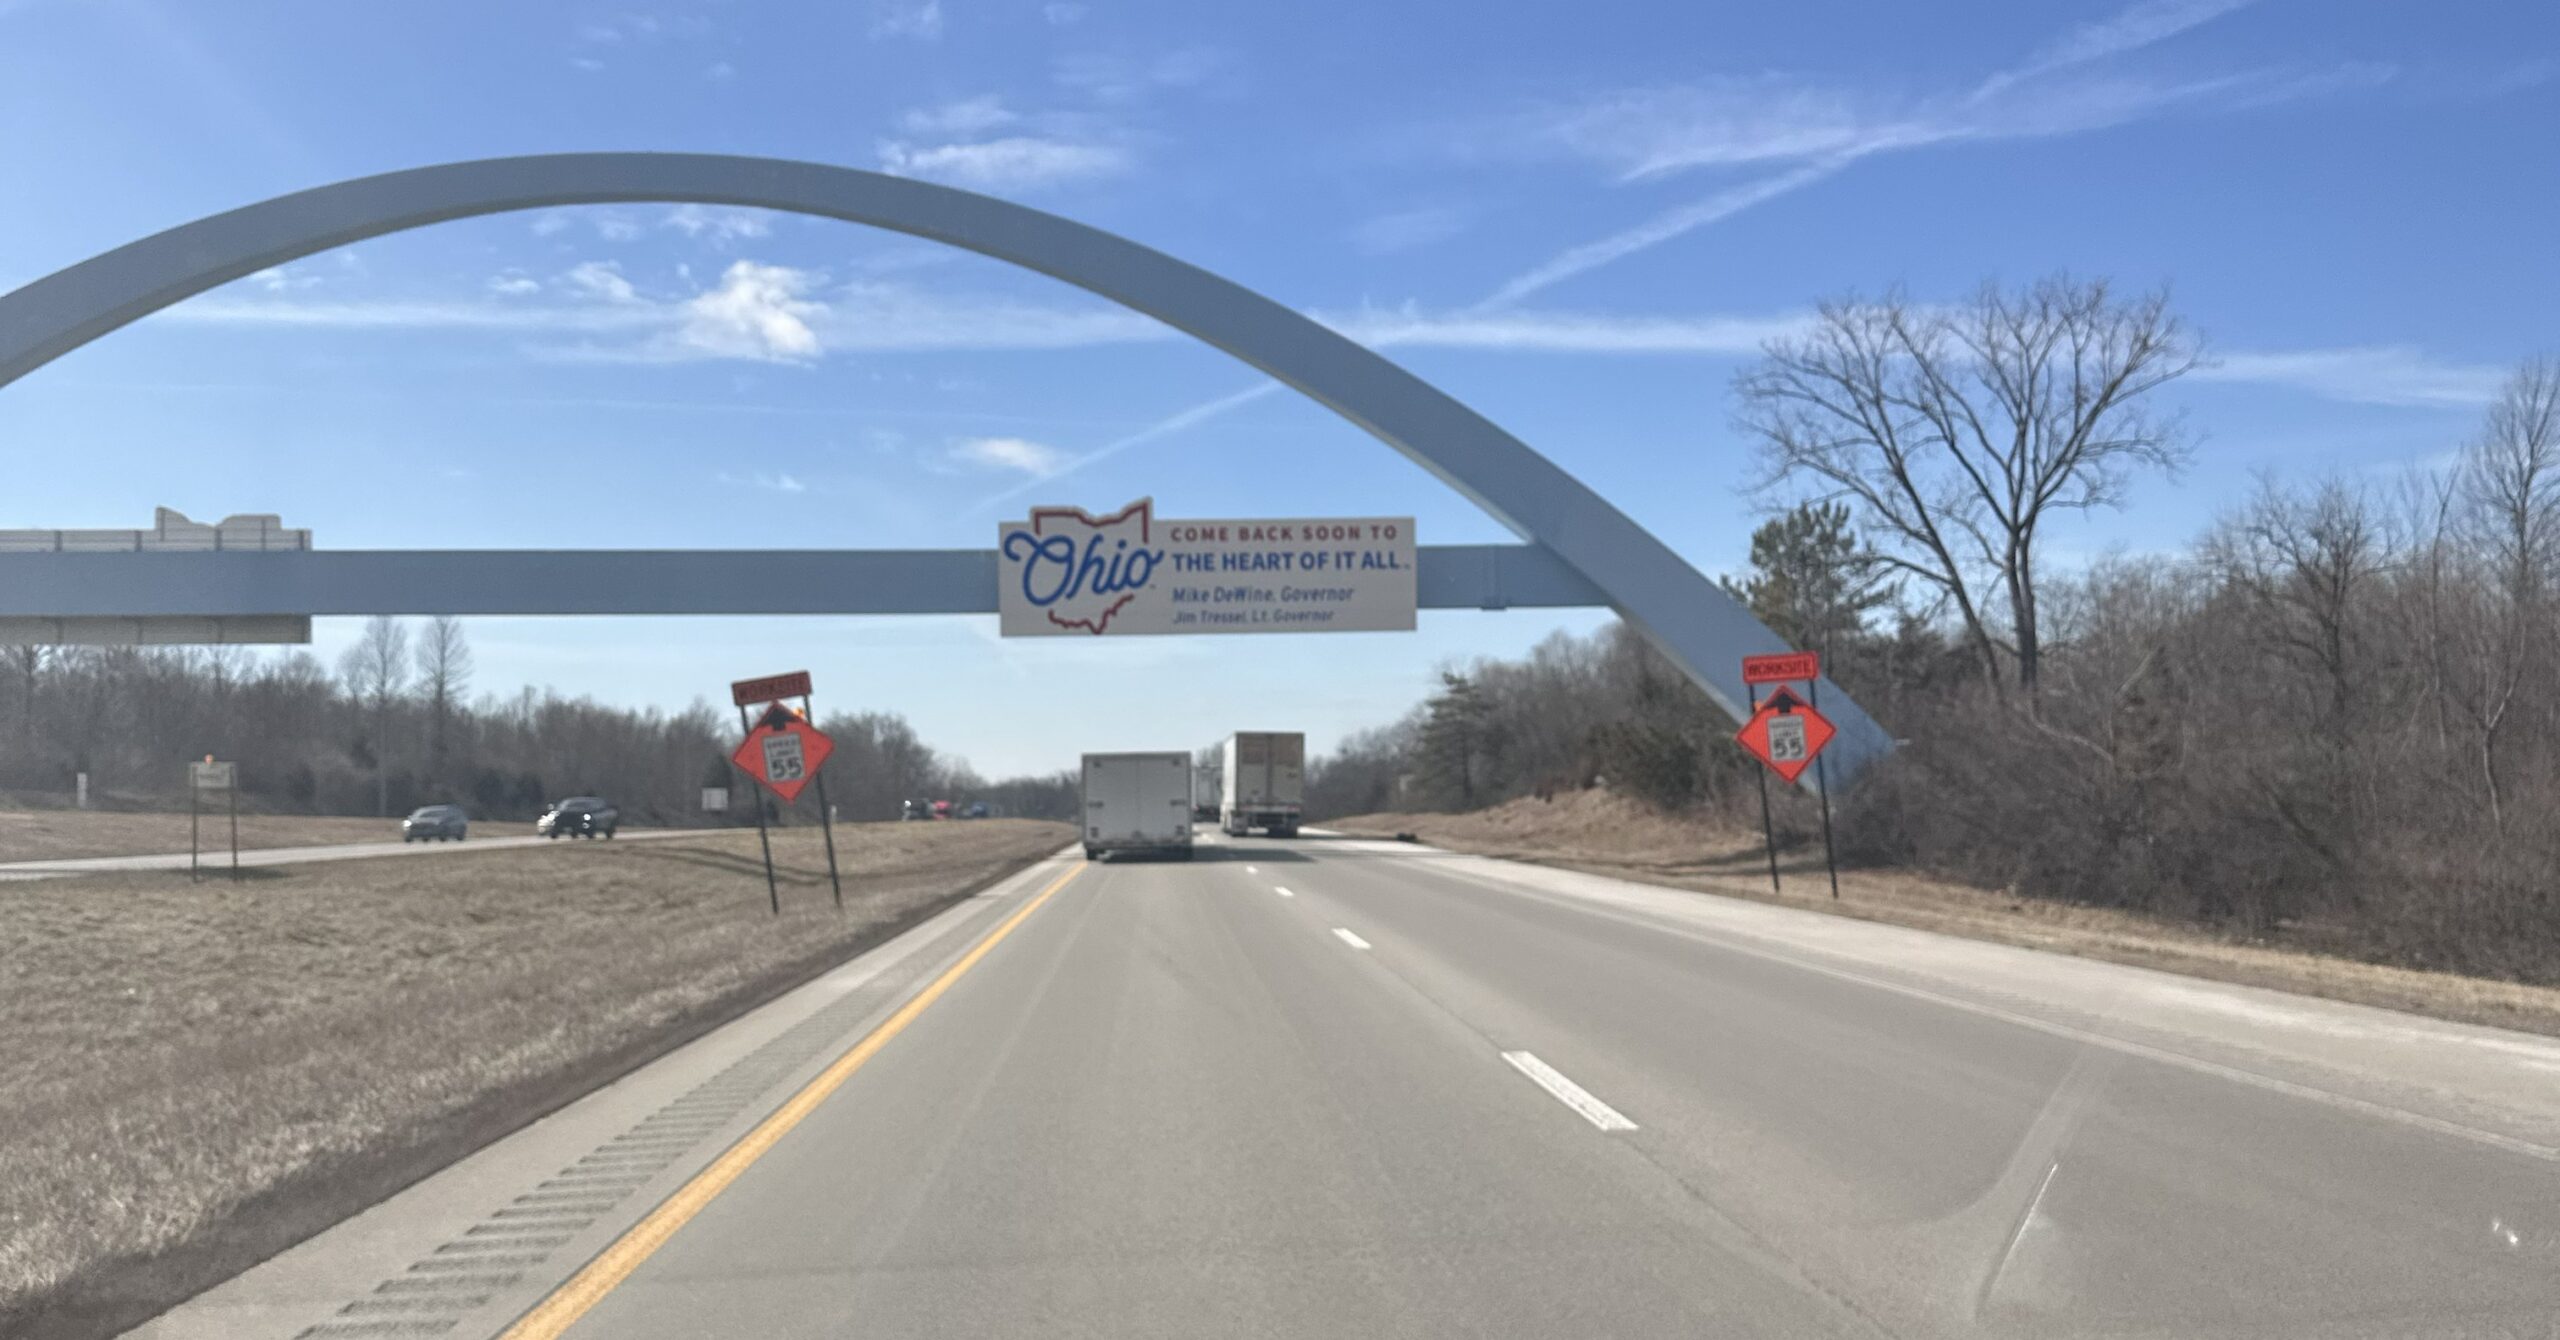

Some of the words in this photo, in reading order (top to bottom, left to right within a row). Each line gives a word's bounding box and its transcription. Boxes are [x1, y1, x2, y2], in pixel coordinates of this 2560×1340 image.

[1170, 526, 1230, 542] COME
[1238, 526, 1293, 541] BACK
[1302, 525, 1361, 541] SOON
[1370, 524, 1397, 541] TO
[1004, 531, 1164, 606] Ohio
[1172, 552, 1215, 572] THE
[1222, 551, 1295, 572] HEART
[1300, 550, 1329, 571] OF
[1335, 551, 1356, 570] IT
[1172, 587, 1209, 602] Mike
[1281, 585, 1354, 602] Governor
[1273, 608, 1335, 623] Governor
[1773, 737, 1803, 758] 55
[771, 756, 802, 779] 55
